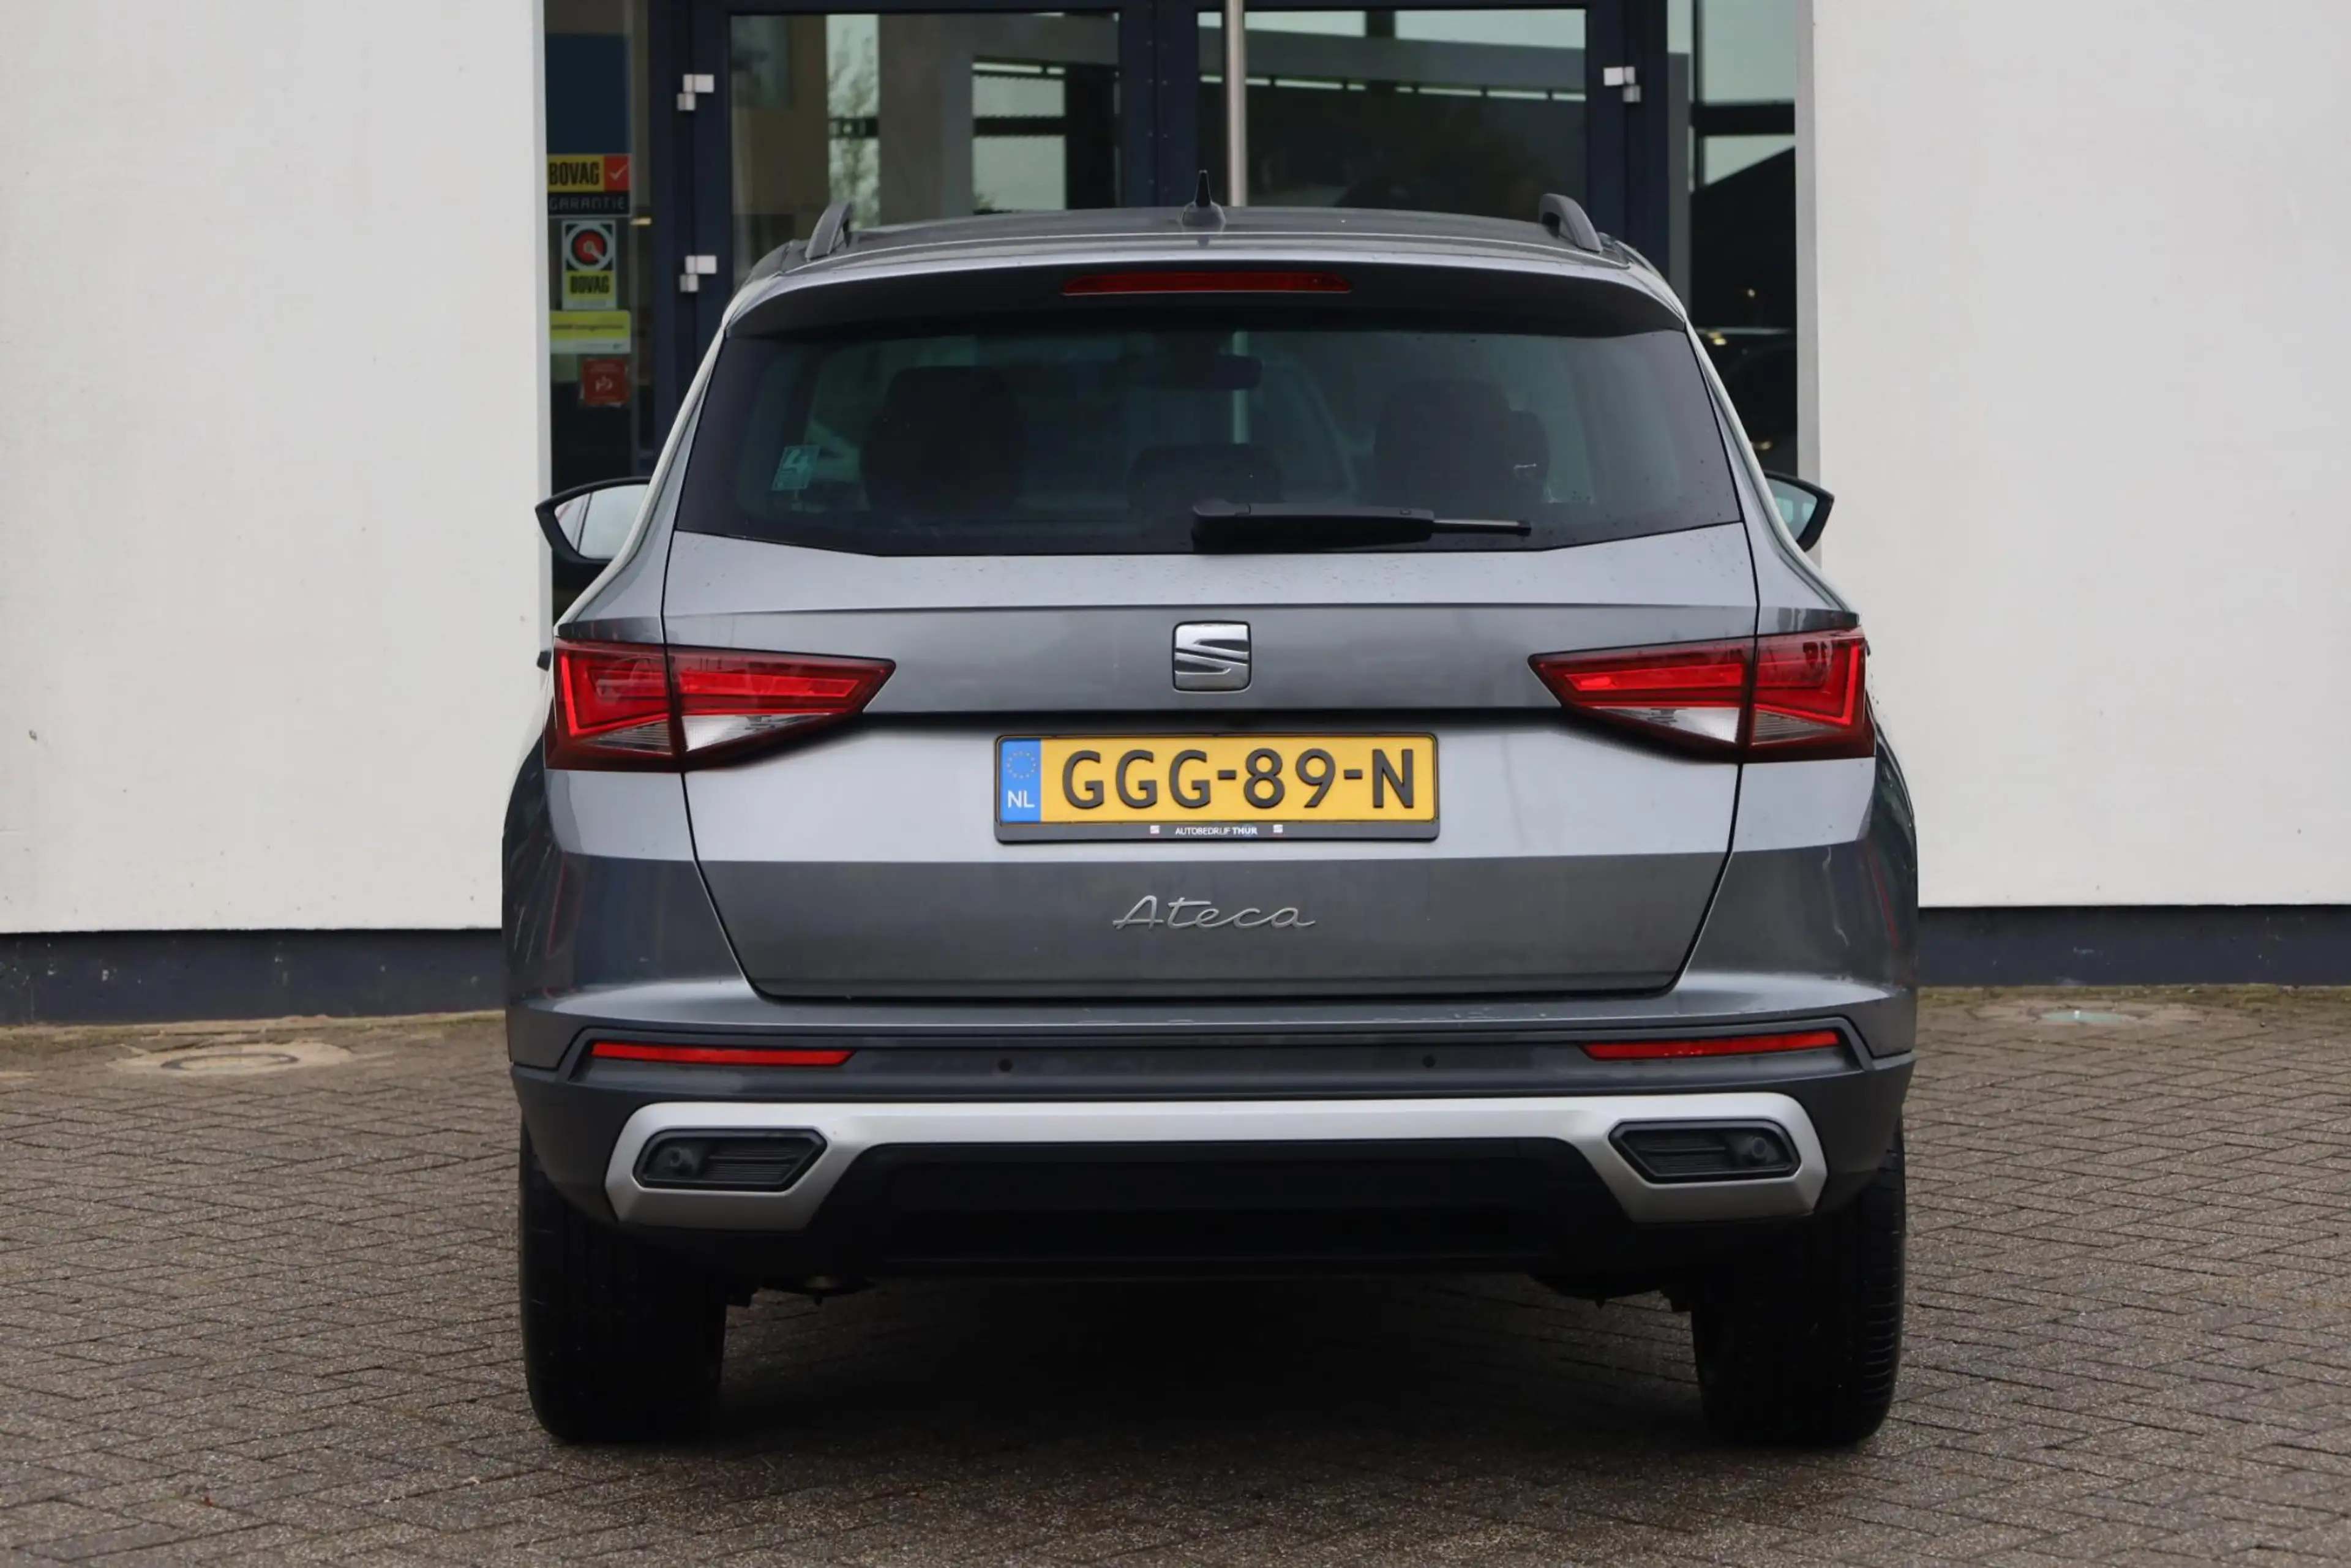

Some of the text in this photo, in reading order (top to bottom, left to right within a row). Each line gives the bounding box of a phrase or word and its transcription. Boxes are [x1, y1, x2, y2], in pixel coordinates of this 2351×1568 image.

[549, 161, 600, 186] BOVAG
[1062, 748, 1415, 809] GGG-89-N
[1008, 789, 1035, 809] NL
[1112, 895, 1316, 930] Ateca
